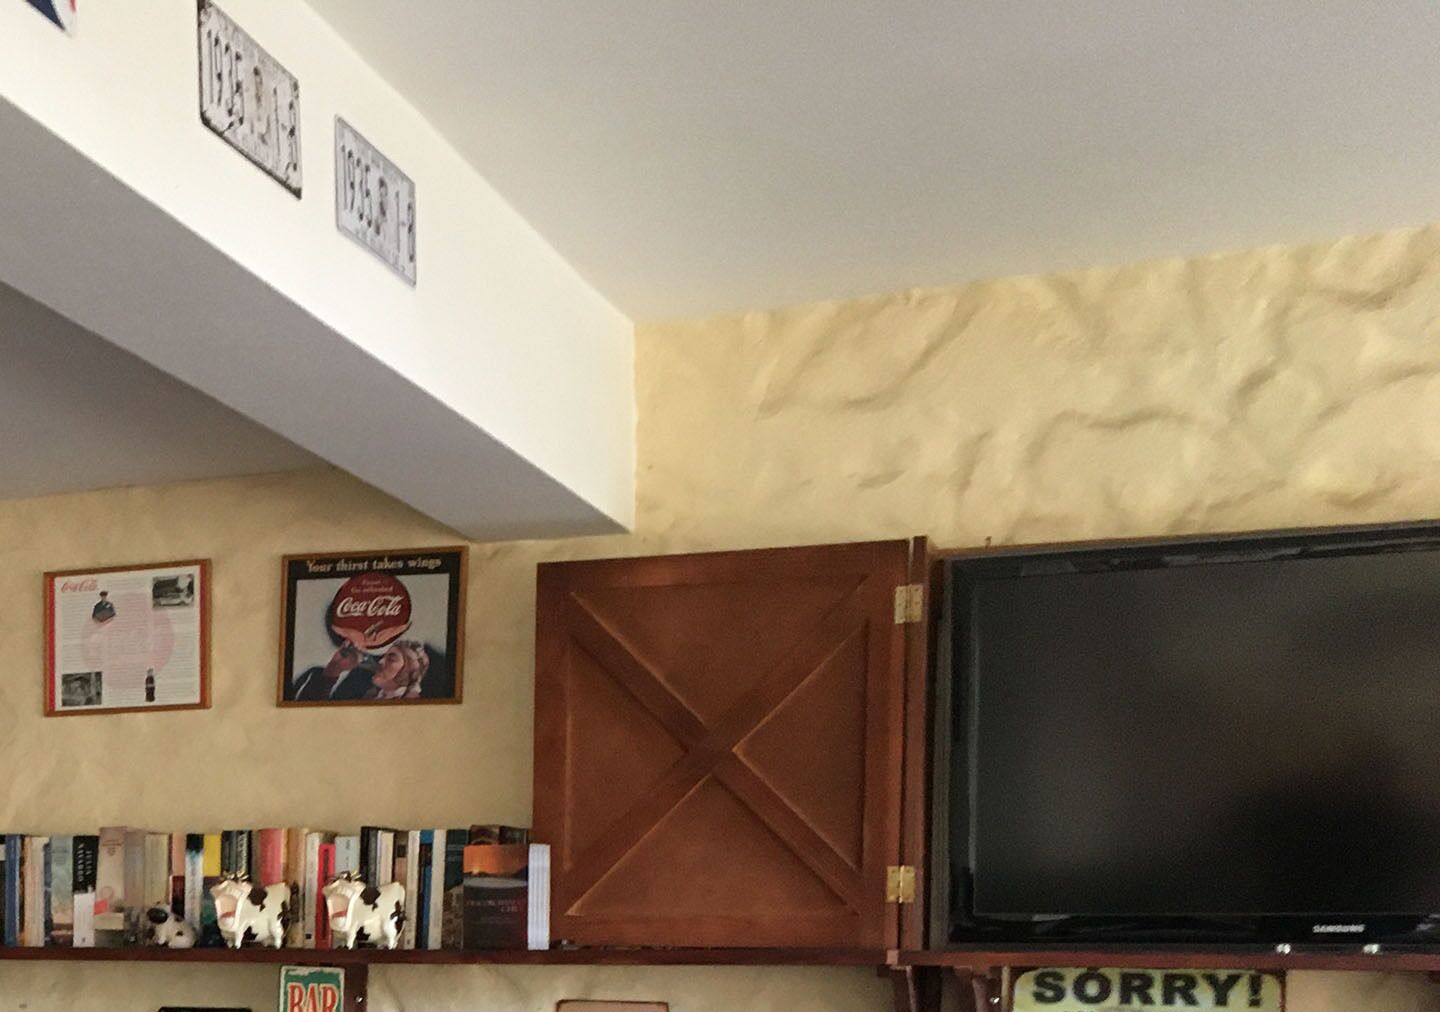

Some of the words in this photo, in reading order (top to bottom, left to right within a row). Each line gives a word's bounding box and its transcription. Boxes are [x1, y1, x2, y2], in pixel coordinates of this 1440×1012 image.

[207, 28, 244, 127] 1935
[340, 143, 372, 229] 1935
[307, 560, 333, 573] Your
[335, 558, 369, 572] thirst
[372, 556, 404, 570] takes
[407, 557, 443, 570] wings
[336, 595, 404, 618] Coca-Cola
[1312, 924, 1366, 933] SAMSUNG
[1032, 970, 1263, 1007] SORRY!
